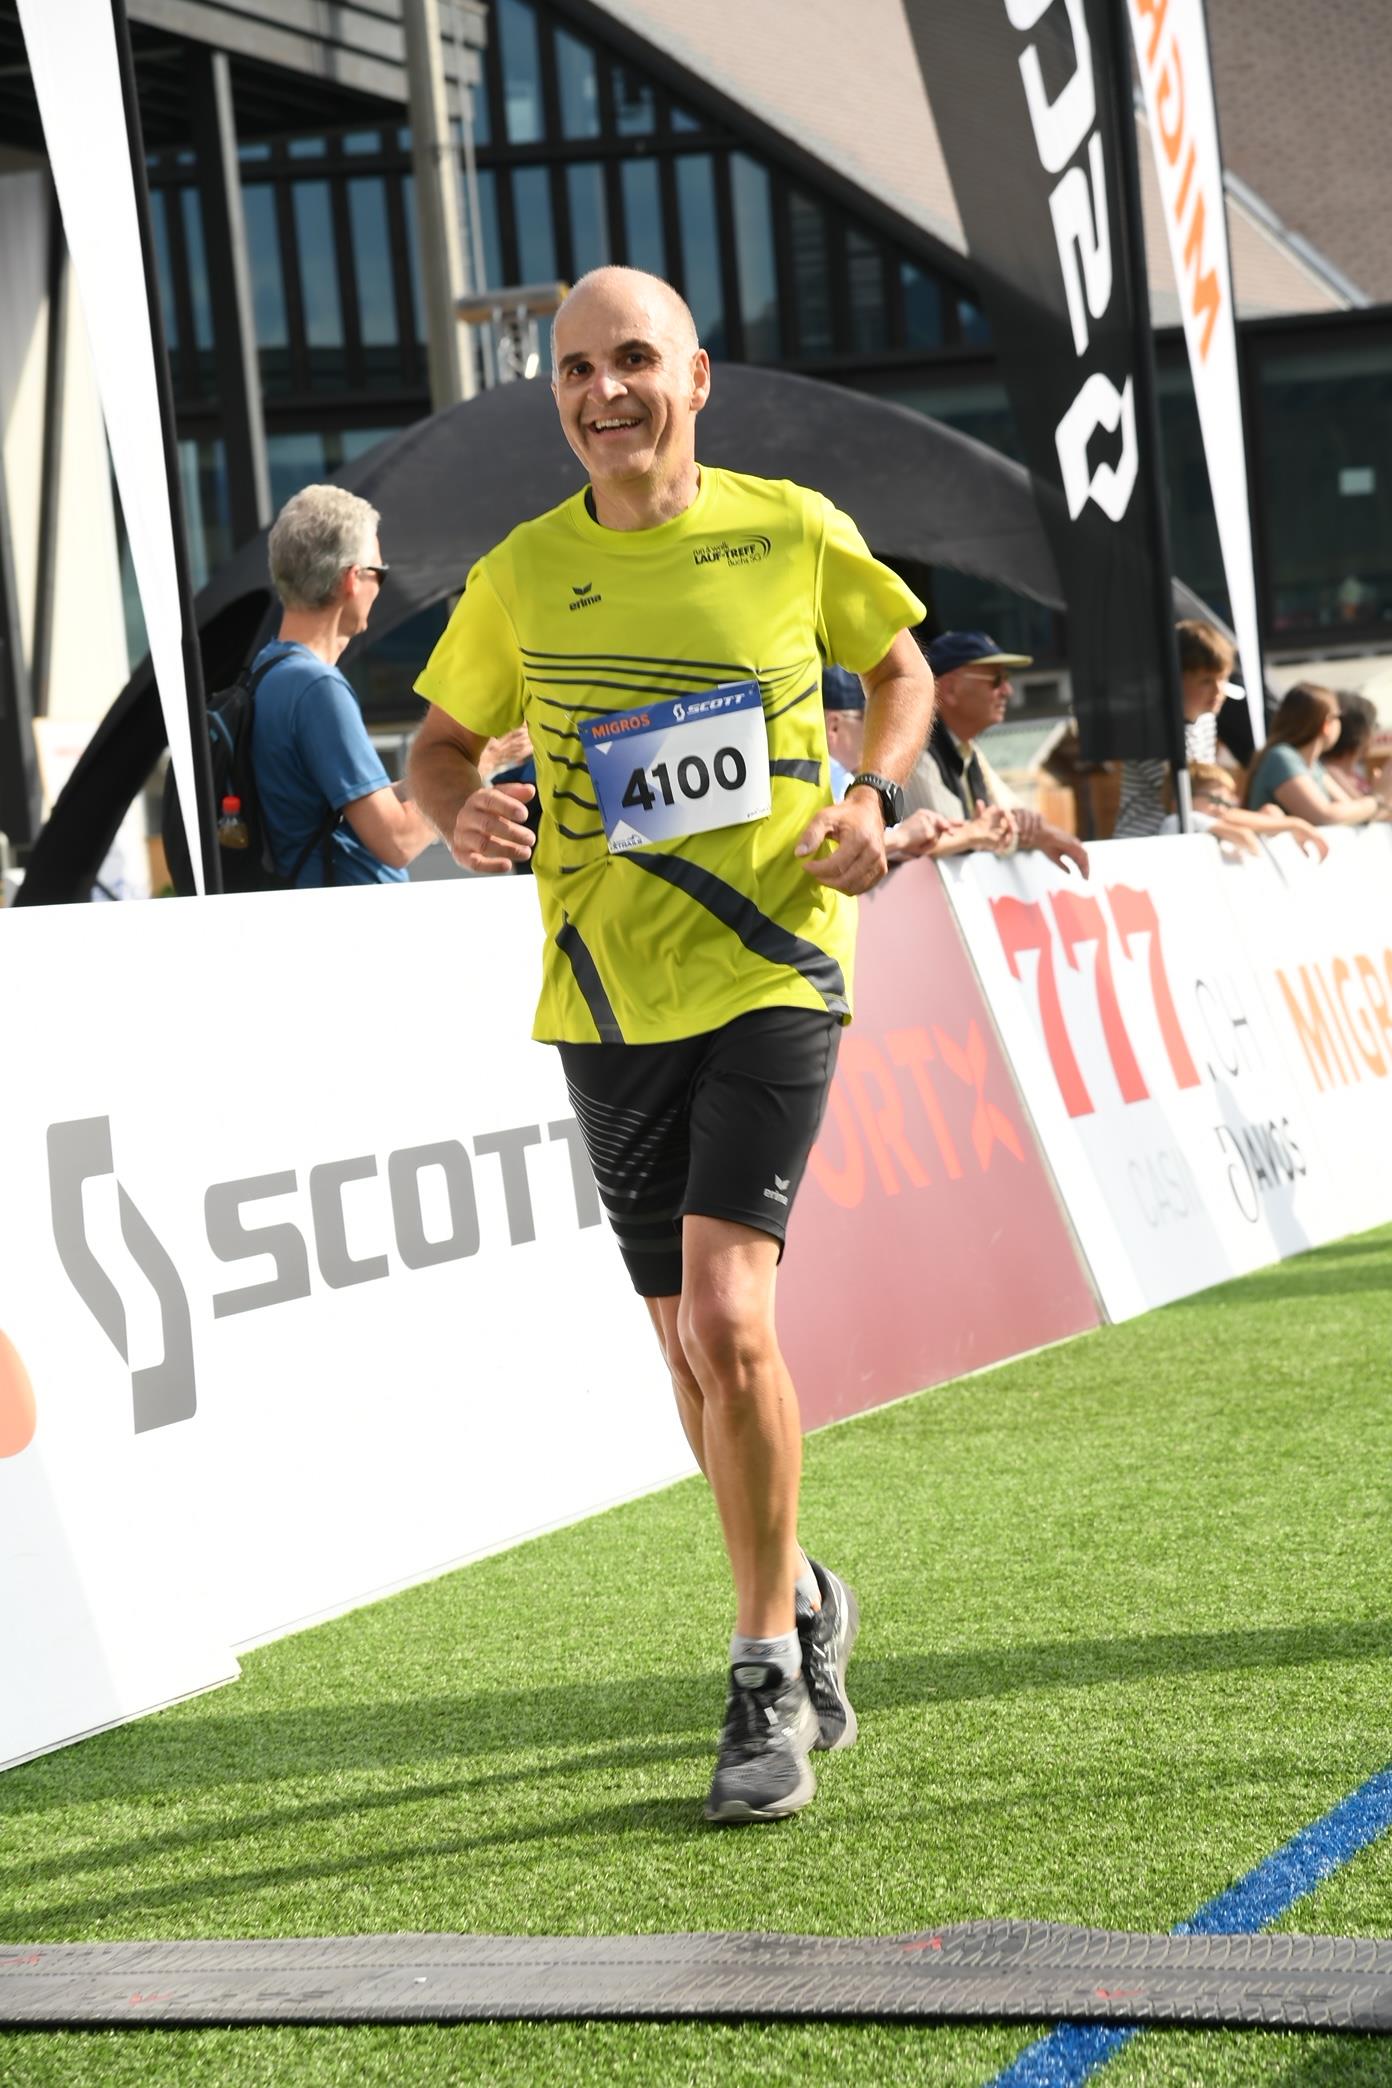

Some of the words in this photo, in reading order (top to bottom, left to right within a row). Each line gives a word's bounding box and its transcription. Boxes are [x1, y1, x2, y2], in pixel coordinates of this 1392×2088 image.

[694, 544, 756, 565] LAUF-TREFF
[569, 594, 602, 611] erima
[591, 713, 652, 739] MIGROS
[687, 692, 746, 716] SCOTT
[621, 746, 747, 811] 4100
[1275, 947, 1392, 1093] MIGR
[808, 1018, 1025, 1209] ORTX
[203, 1117, 602, 1320] SCOTT
